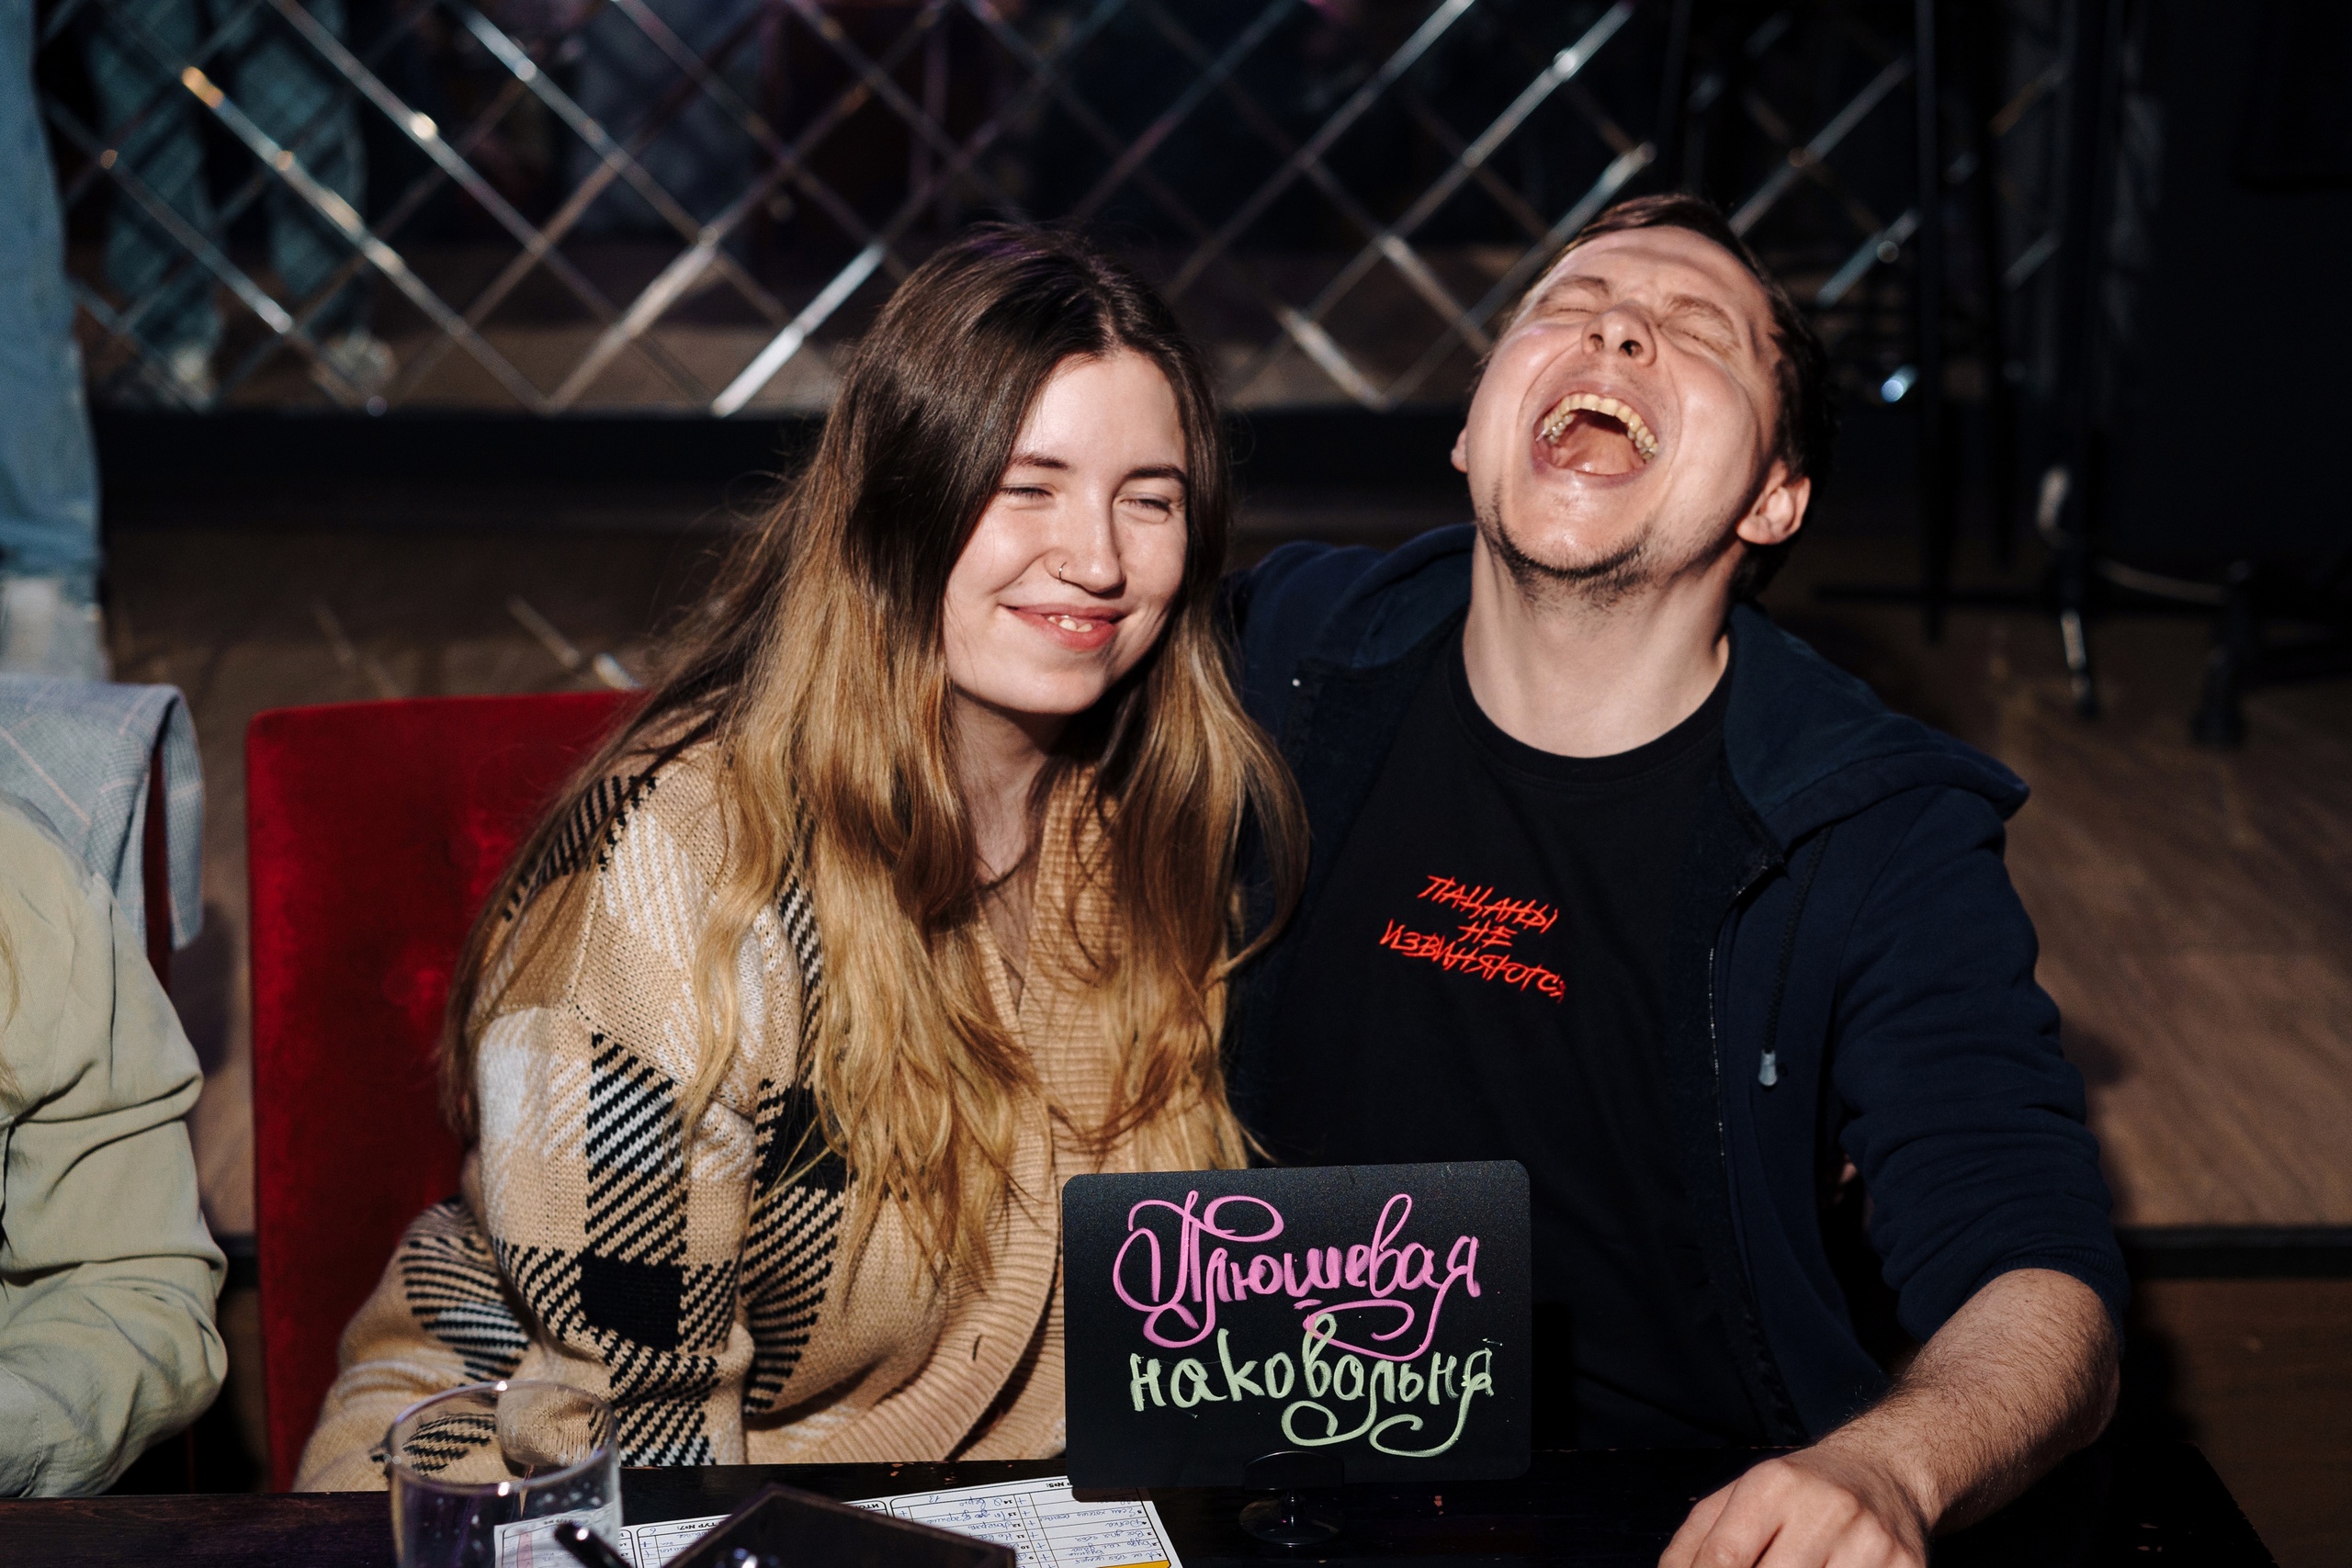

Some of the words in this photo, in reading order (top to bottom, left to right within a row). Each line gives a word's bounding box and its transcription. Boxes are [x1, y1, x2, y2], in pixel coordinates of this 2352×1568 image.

[1417, 874, 1559, 934] ПАЦАНЫ
[1457, 919, 1518, 948] НЕ
[1113, 1190, 1482, 1361] Плюшевая
[1129, 1313, 1495, 1458] наковальня
